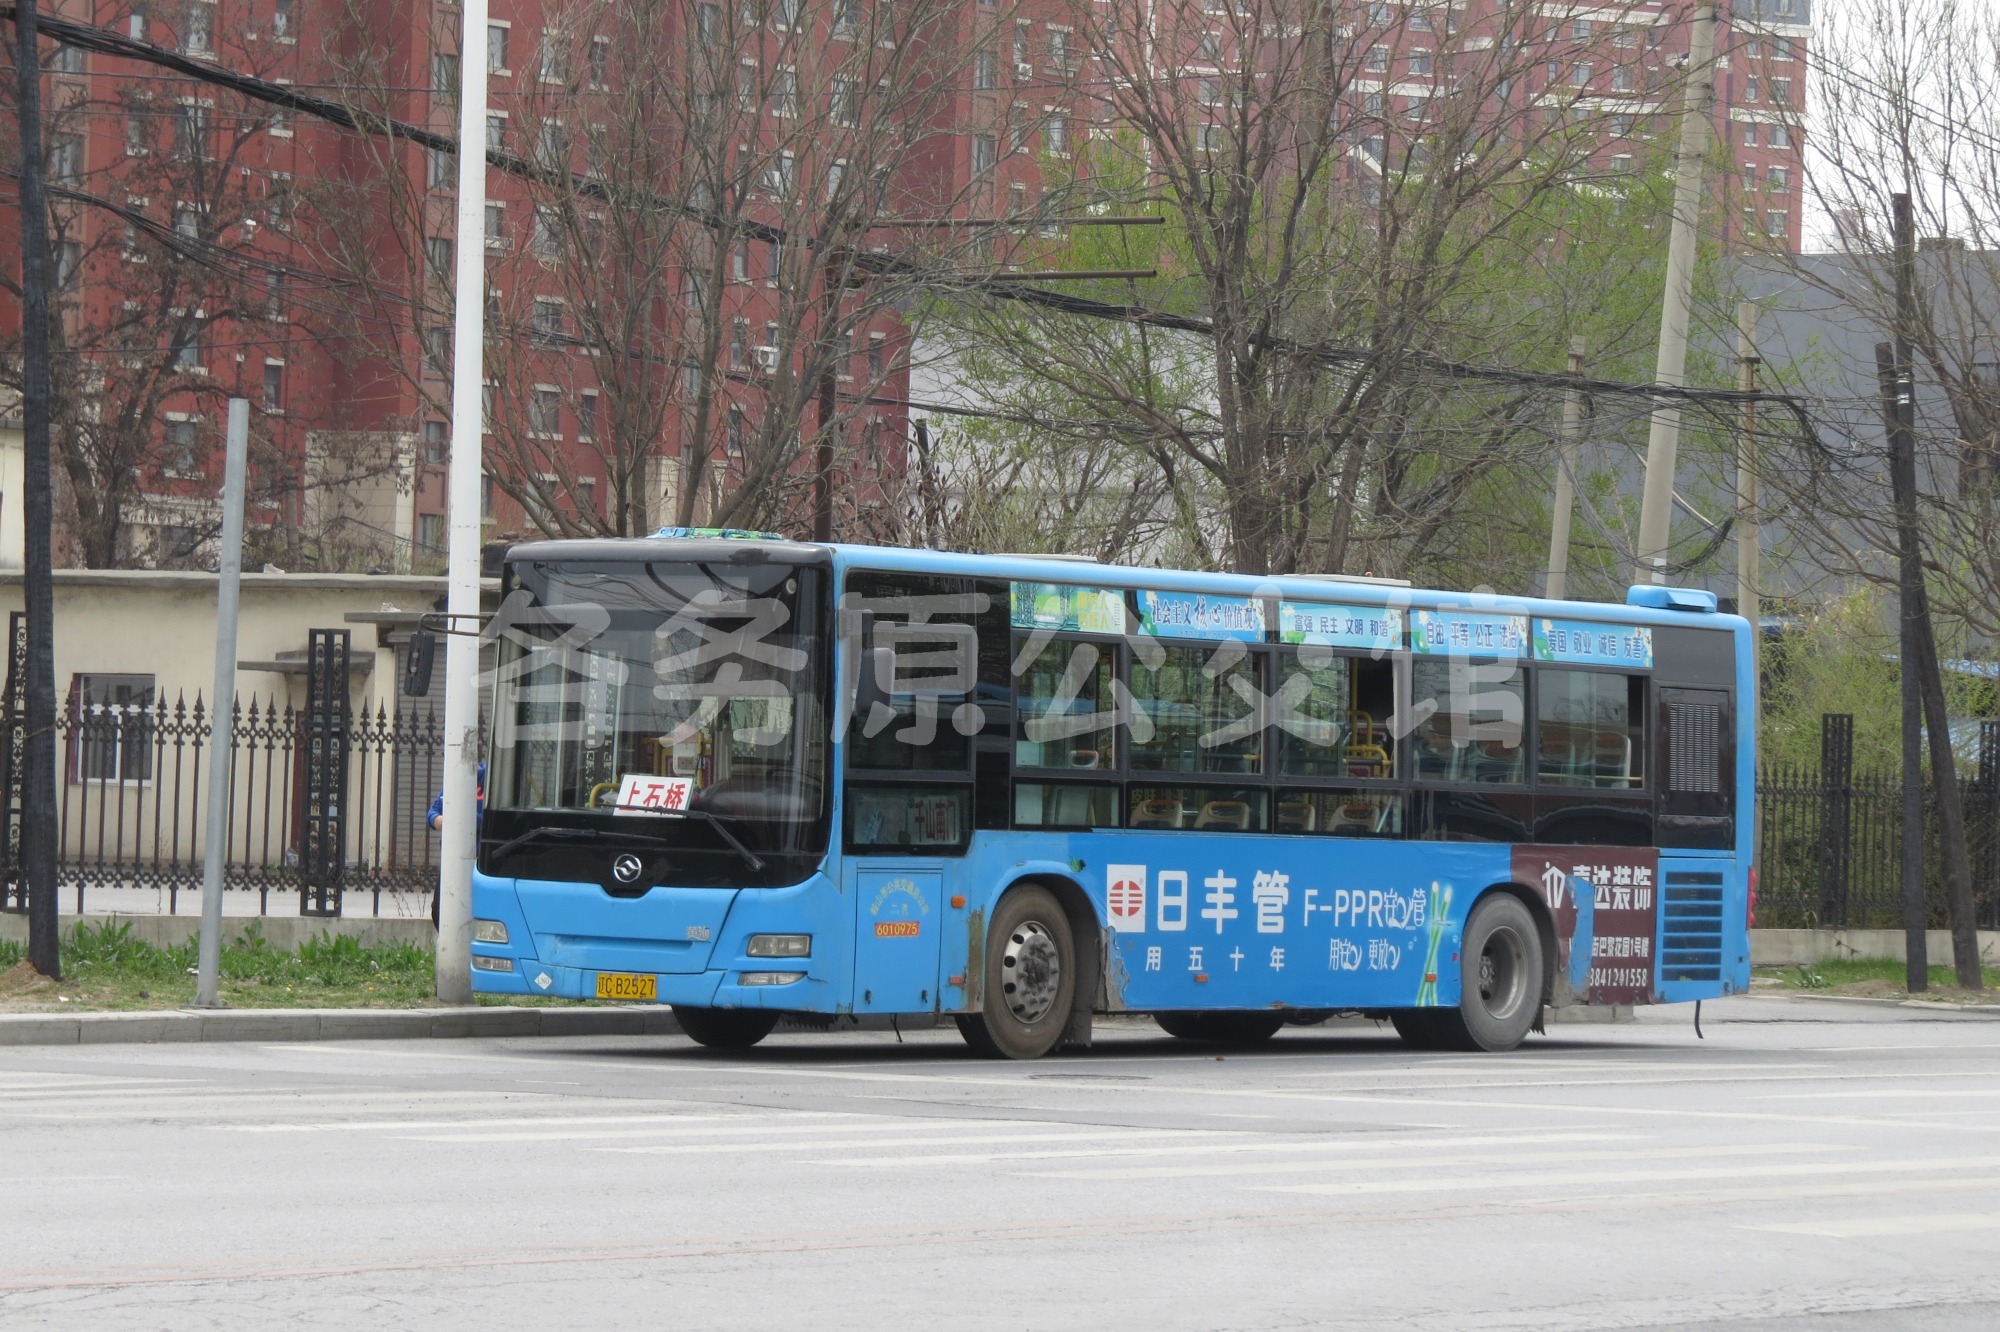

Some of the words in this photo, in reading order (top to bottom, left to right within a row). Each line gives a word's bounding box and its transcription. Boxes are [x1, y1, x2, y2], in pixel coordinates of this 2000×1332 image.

[1152, 595, 1254, 630] 社会主义核心价值观
[1294, 614, 1314, 633] 富强
[1320, 616, 1338, 634] 民主
[1345, 618, 1364, 636] 文明
[1369, 619, 1388, 637] 和谐
[1426, 620, 1445, 645] 自由
[1451, 621, 1469, 646] 平等
[1475, 623, 1494, 648] 公正
[1499, 624, 1518, 649] 法治
[1547, 629, 1567, 653] 爱国
[1572, 631, 1592, 655] 敬业
[1598, 633, 1617, 657] 诚信
[1623, 635, 1641, 659] 友善
[618, 781, 686, 815] 上石桥
[1157, 869, 1290, 935] 日丰管
[876, 923, 918, 936] 6010975
[1145, 945, 1285, 972] 用五十年
